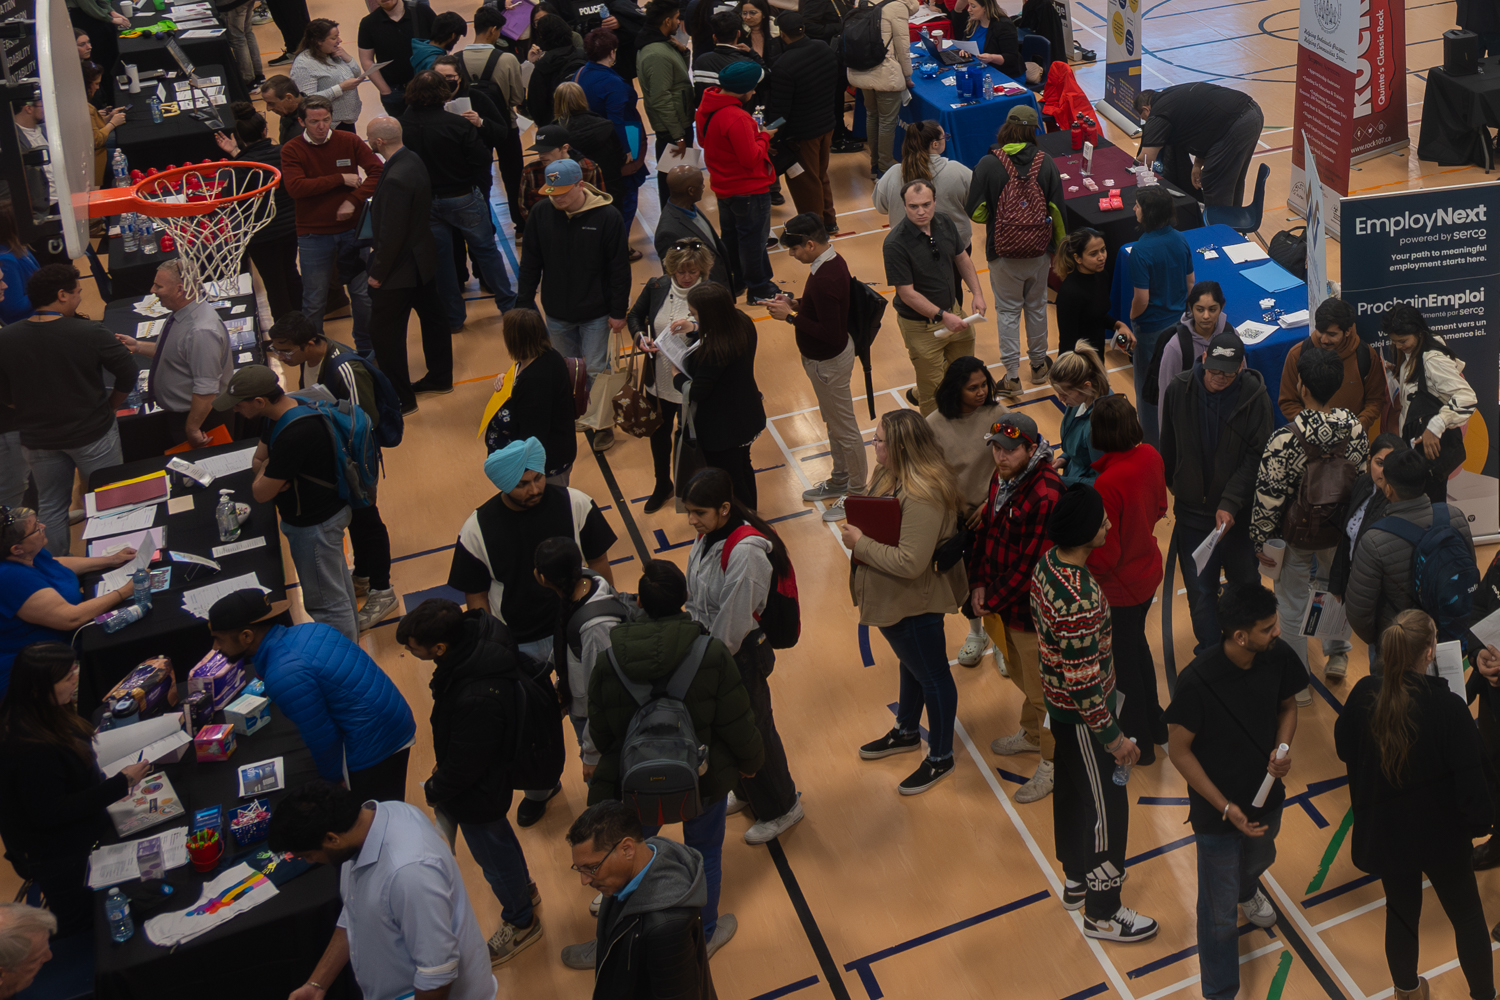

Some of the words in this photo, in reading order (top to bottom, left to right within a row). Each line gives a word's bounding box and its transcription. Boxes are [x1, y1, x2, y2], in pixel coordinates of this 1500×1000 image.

[1052, 3, 1066, 18] dge
[1377, 9, 1385, 33] Rock
[1377, 34, 1385, 65] Classic
[1378, 66, 1386, 105] Quinte's
[1350, 136, 1392, 154] www.rock107.ca
[1355, 204, 1487, 237] EmployNext
[1400, 234, 1439, 246] powered
[1441, 232, 1451, 241] by
[1453, 229, 1487, 240] serco
[1391, 253, 1410, 261] Your
[1411, 250, 1430, 260] path
[1441, 244, 1487, 256] meaningful
[1389, 260, 1441, 271] employment
[1443, 258, 1465, 266] starts
[1421, 311, 1446, 319] imenté
[1459, 307, 1485, 316] serco
[1458, 320, 1475, 328] vers
[1443, 332, 1473, 340] mmence
[1086, 877, 1122, 891] dida
